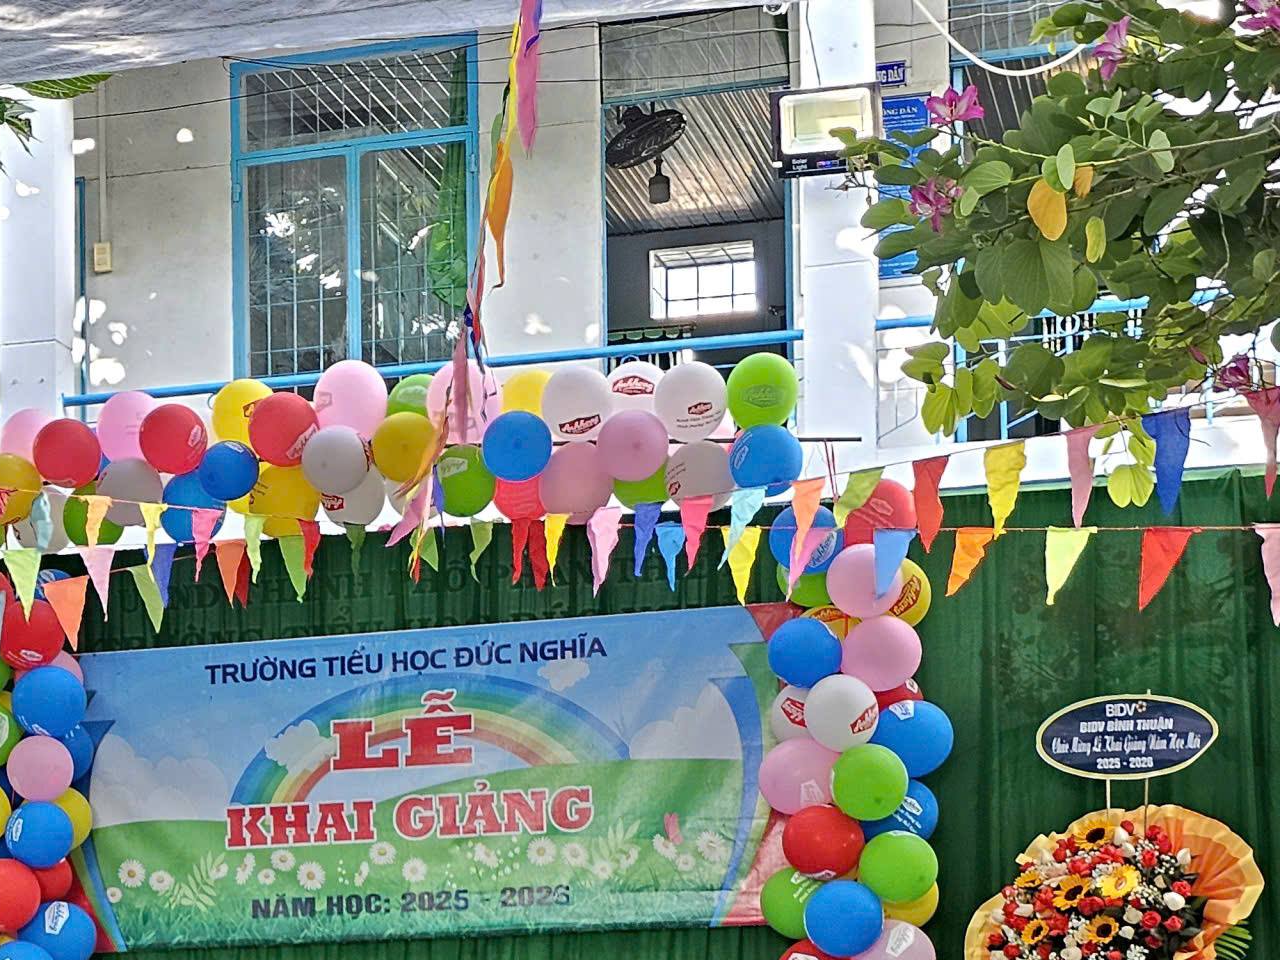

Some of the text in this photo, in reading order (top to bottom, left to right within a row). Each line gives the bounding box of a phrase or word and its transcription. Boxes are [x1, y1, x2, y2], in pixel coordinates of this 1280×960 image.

[205, 632, 608, 686] TRƯỜNG TIỂU HỌC ĐỨC NGHĨA
[1105, 703, 1136, 718] BIDV
[330, 689, 475, 772] LỄ
[1080, 717, 1174, 733] BIDV BÌNH THUẬN
[1052, 737, 1069, 754] Chúc
[1071, 736, 1091, 756] Mừng
[1104, 735, 1123, 752] Khai
[1124, 734, 1147, 754] Giảng
[1148, 734, 1167, 750] Năm
[1169, 733, 1184, 752] Học
[1097, 757, 1120, 769] 2025
[226, 780, 594, 850] KHAI GIẢNG
[251, 889, 317, 919] NĂM
[325, 890, 390, 918] HỌC:
[400, 888, 469, 914] 2025
[500, 885, 571, 907] 2026
